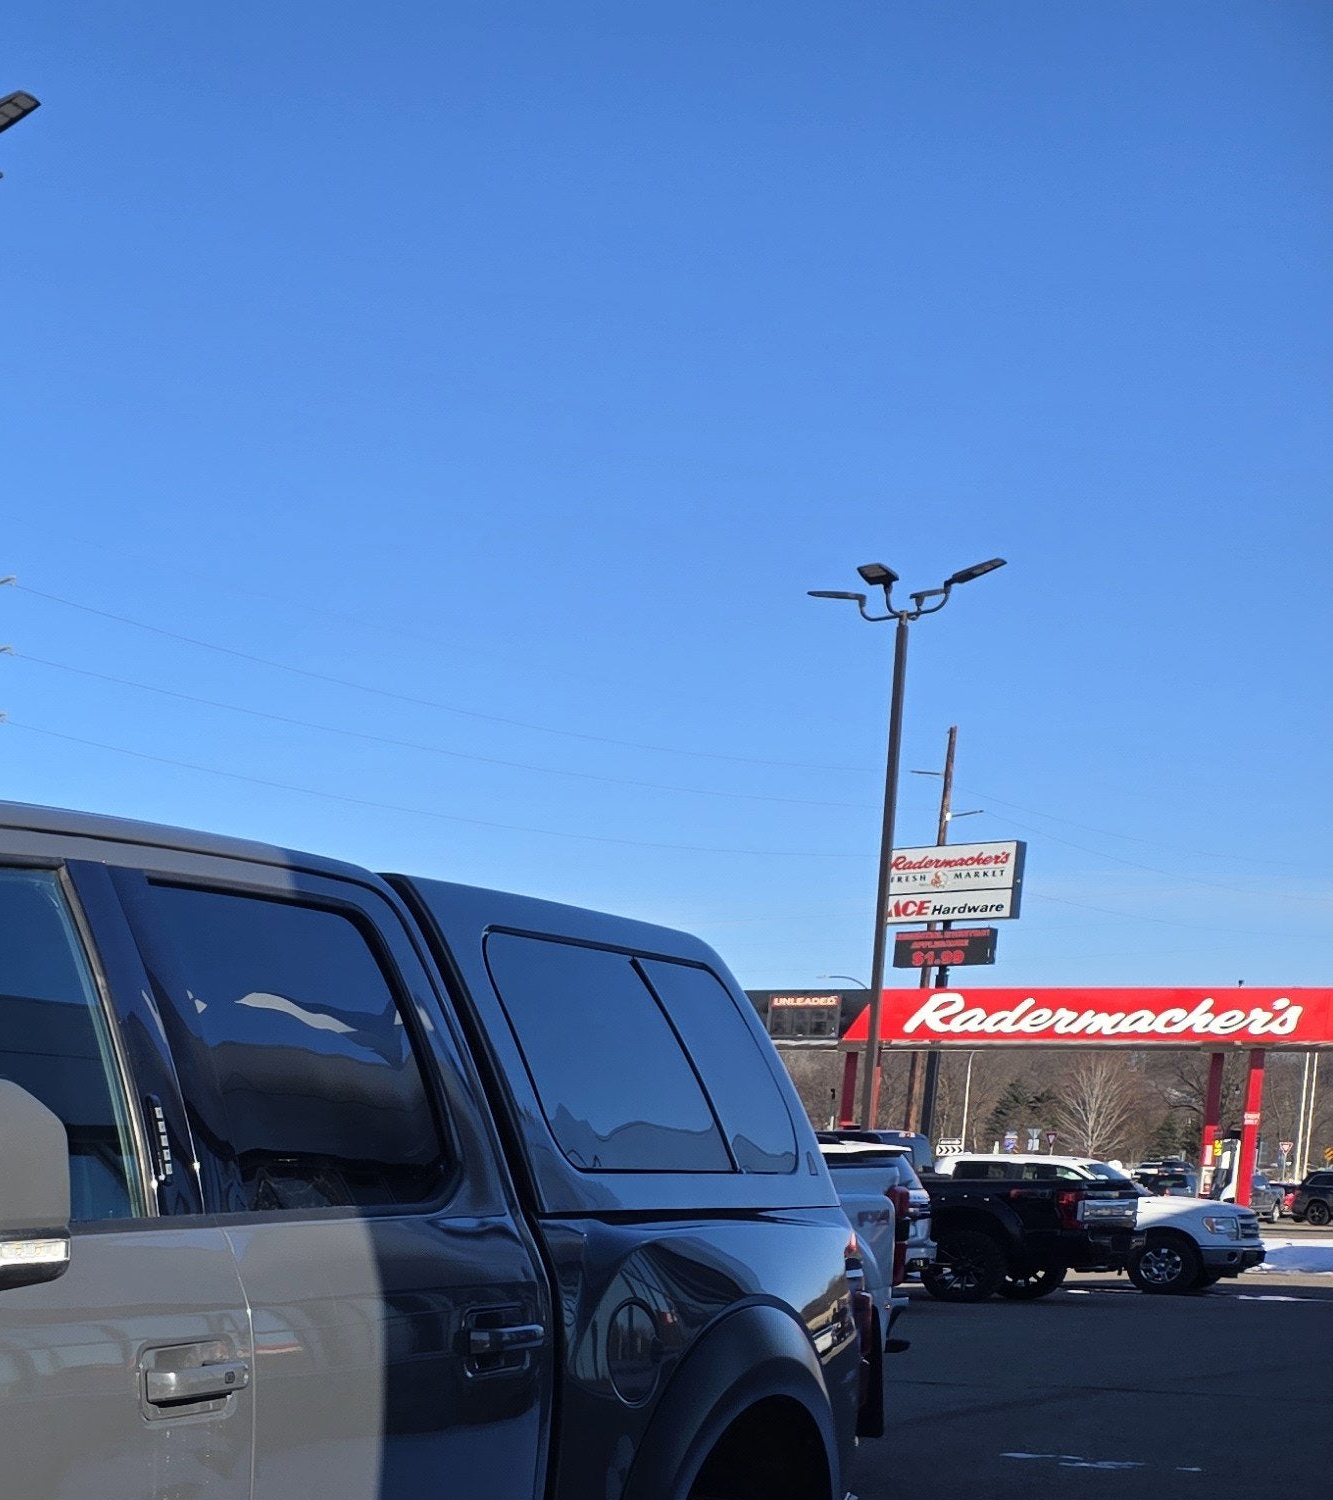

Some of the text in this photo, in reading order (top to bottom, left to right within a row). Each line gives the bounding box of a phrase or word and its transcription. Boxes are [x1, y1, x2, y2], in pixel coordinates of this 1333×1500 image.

[890, 852, 1012, 871] Radermacher's
[890, 869, 1005, 883] FRESH MARKET
[887, 900, 1005, 918] ACE Hardware
[773, 996, 837, 1006] UNLEADED
[902, 992, 1305, 1036] Radermacher's
